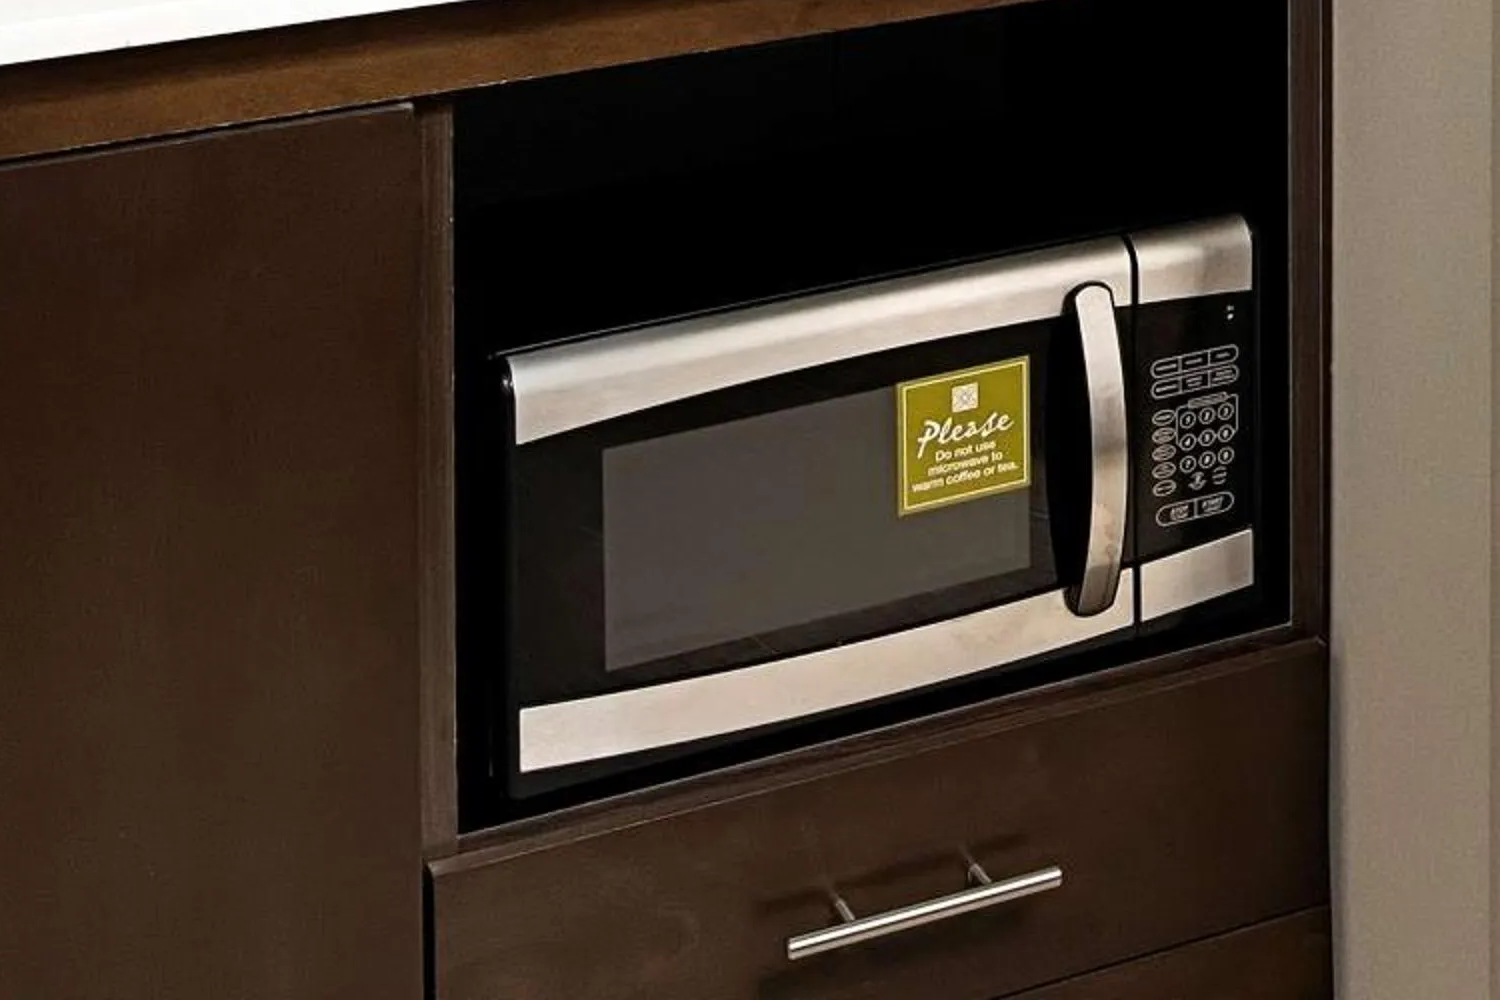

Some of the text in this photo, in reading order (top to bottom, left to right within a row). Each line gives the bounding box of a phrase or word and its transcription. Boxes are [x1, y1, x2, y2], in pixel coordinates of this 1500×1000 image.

[916, 411, 1015, 460] Please
[927, 451, 1003, 477] microwave to
[935, 441, 997, 463] Do not use
[911, 477, 944, 493] warm
[945, 469, 981, 485] coffee
[983, 465, 996, 477] or
